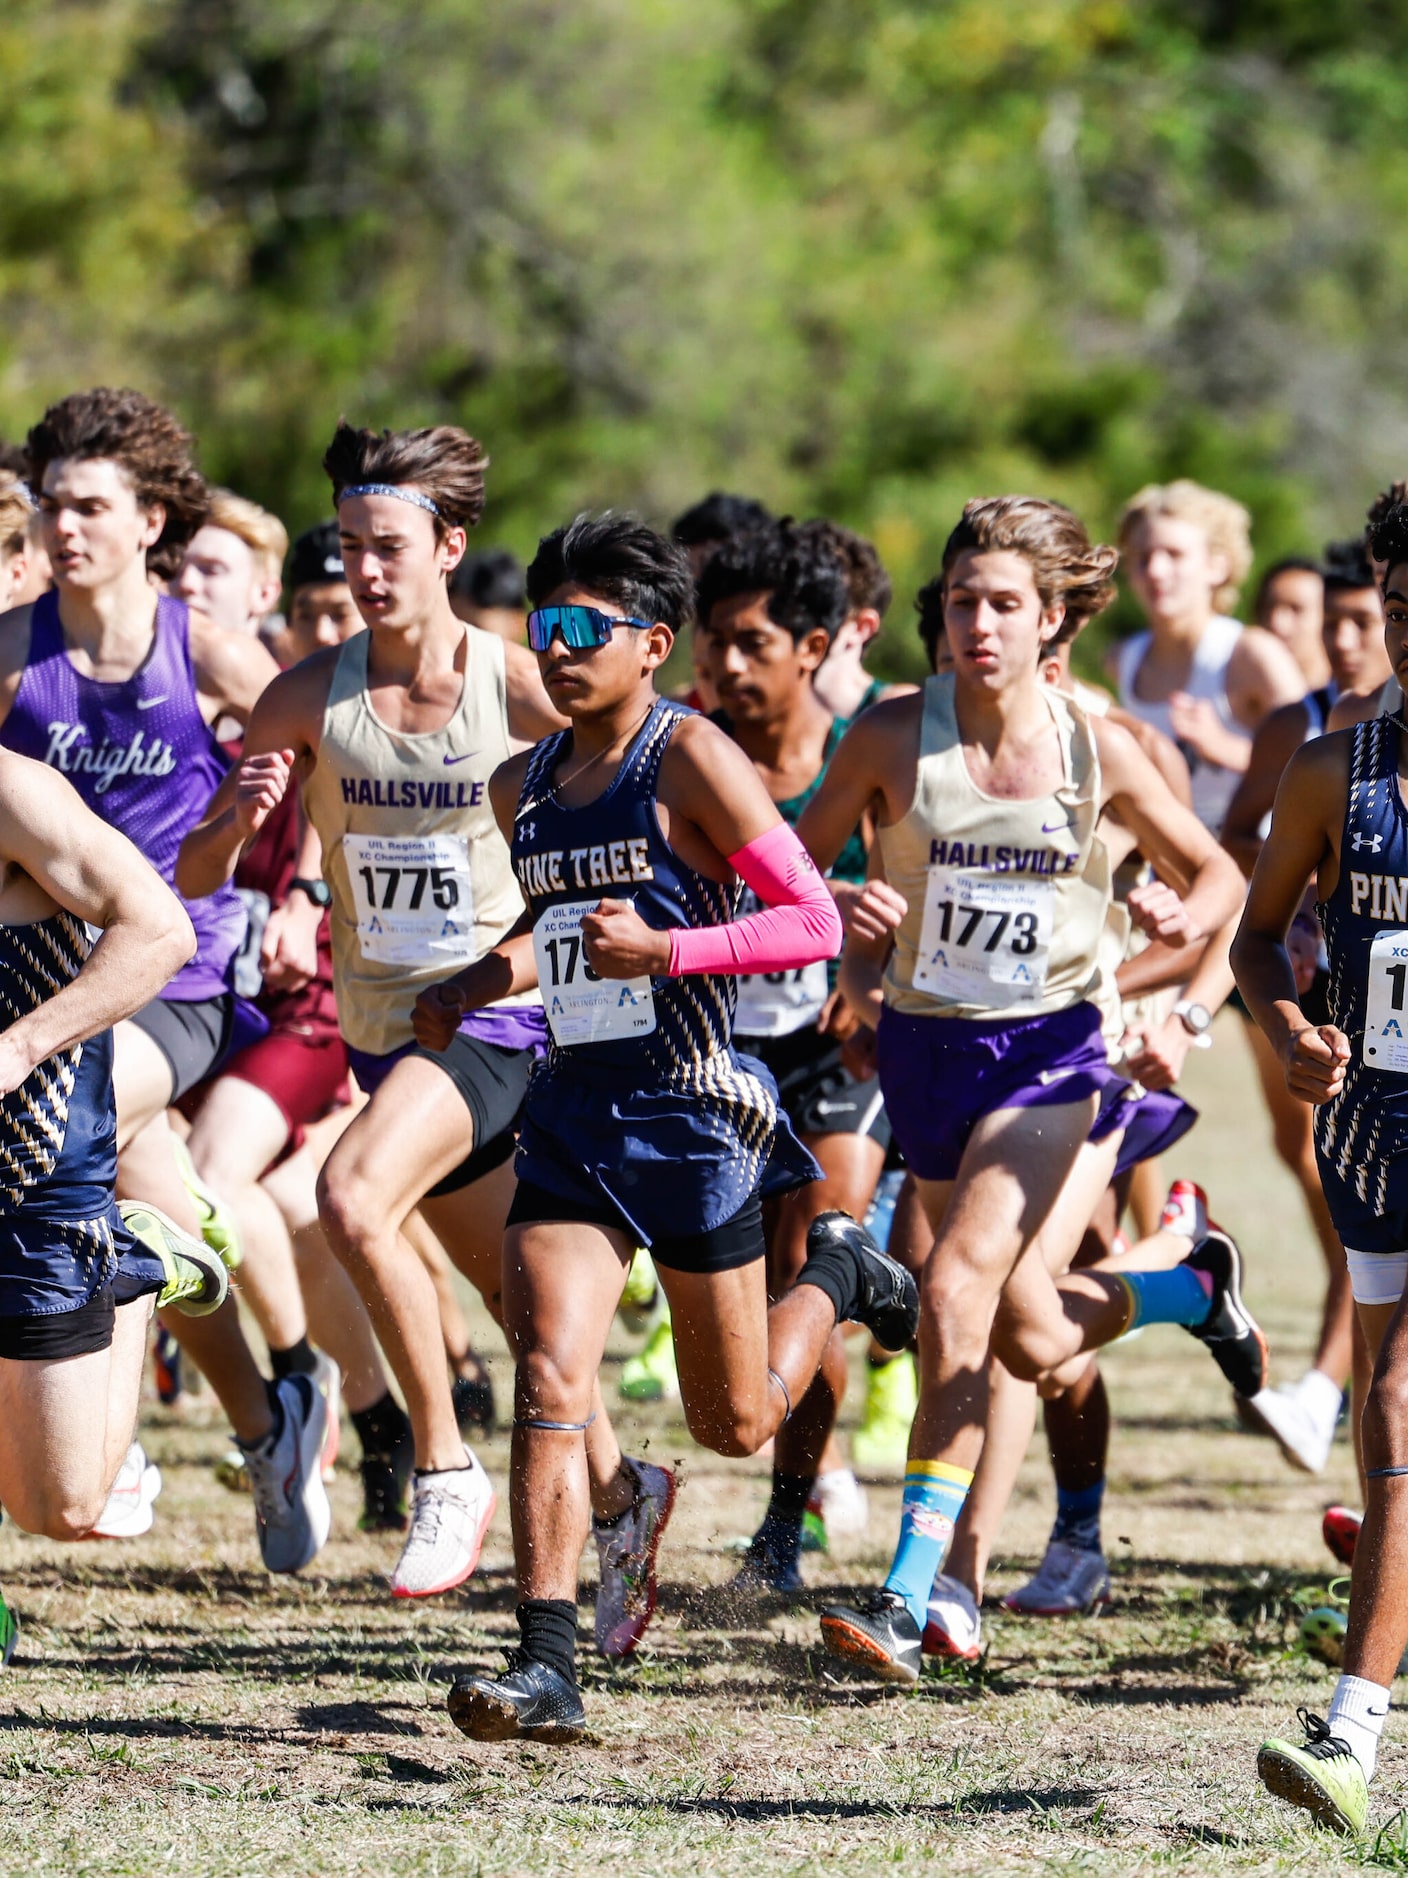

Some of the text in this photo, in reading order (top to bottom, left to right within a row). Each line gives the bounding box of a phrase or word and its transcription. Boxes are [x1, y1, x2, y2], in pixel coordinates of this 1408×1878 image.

[44, 721, 176, 794] Knights
[341, 778, 485, 809] HALLSVILLE
[388, 842, 425, 851] Region
[569, 837, 655, 888] TREE
[929, 838, 1079, 875] HALLSVILLE
[359, 866, 459, 911] 1775
[544, 923, 556, 932] XC
[553, 909, 566, 918] UIL
[937, 901, 1039, 955] 1773
[1392, 947, 1408, 957] XC
